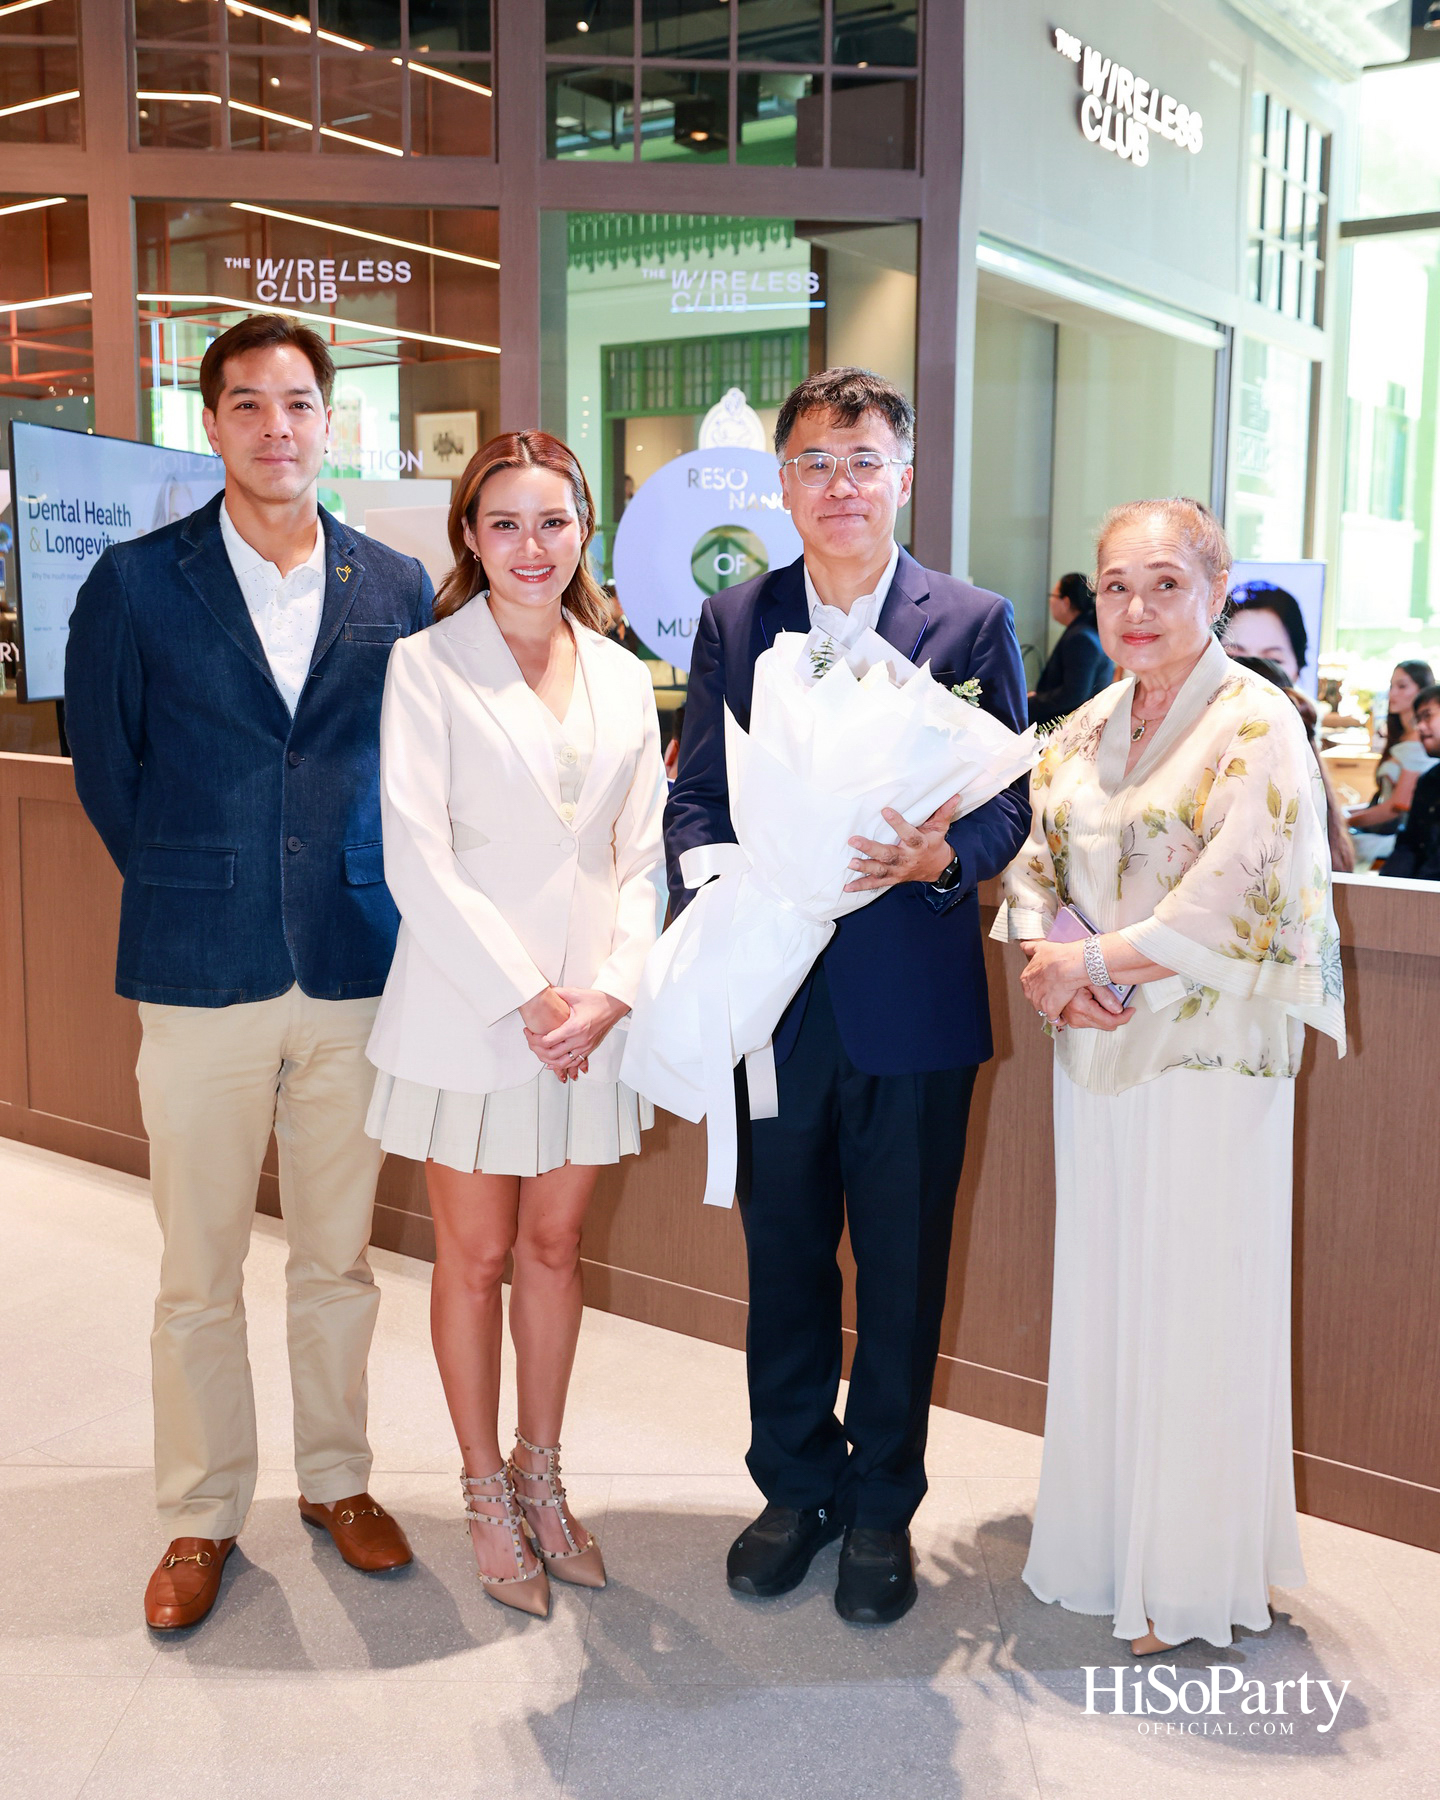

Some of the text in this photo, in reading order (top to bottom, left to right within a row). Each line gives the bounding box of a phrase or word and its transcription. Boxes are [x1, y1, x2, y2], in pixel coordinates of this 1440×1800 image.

[1055, 27, 1203, 155] THE WIRELESS
[1081, 94, 1149, 168] CLUB
[224, 257, 412, 283] THE WIRELESS
[641, 268, 820, 294] THE WIRELESS
[256, 280, 338, 303] CLUB
[671, 291, 748, 313] CLUB
[688, 467, 748, 491] RESO
[28, 494, 132, 528] Dental Health
[29, 526, 41, 553] &
[713, 552, 746, 576] OF
